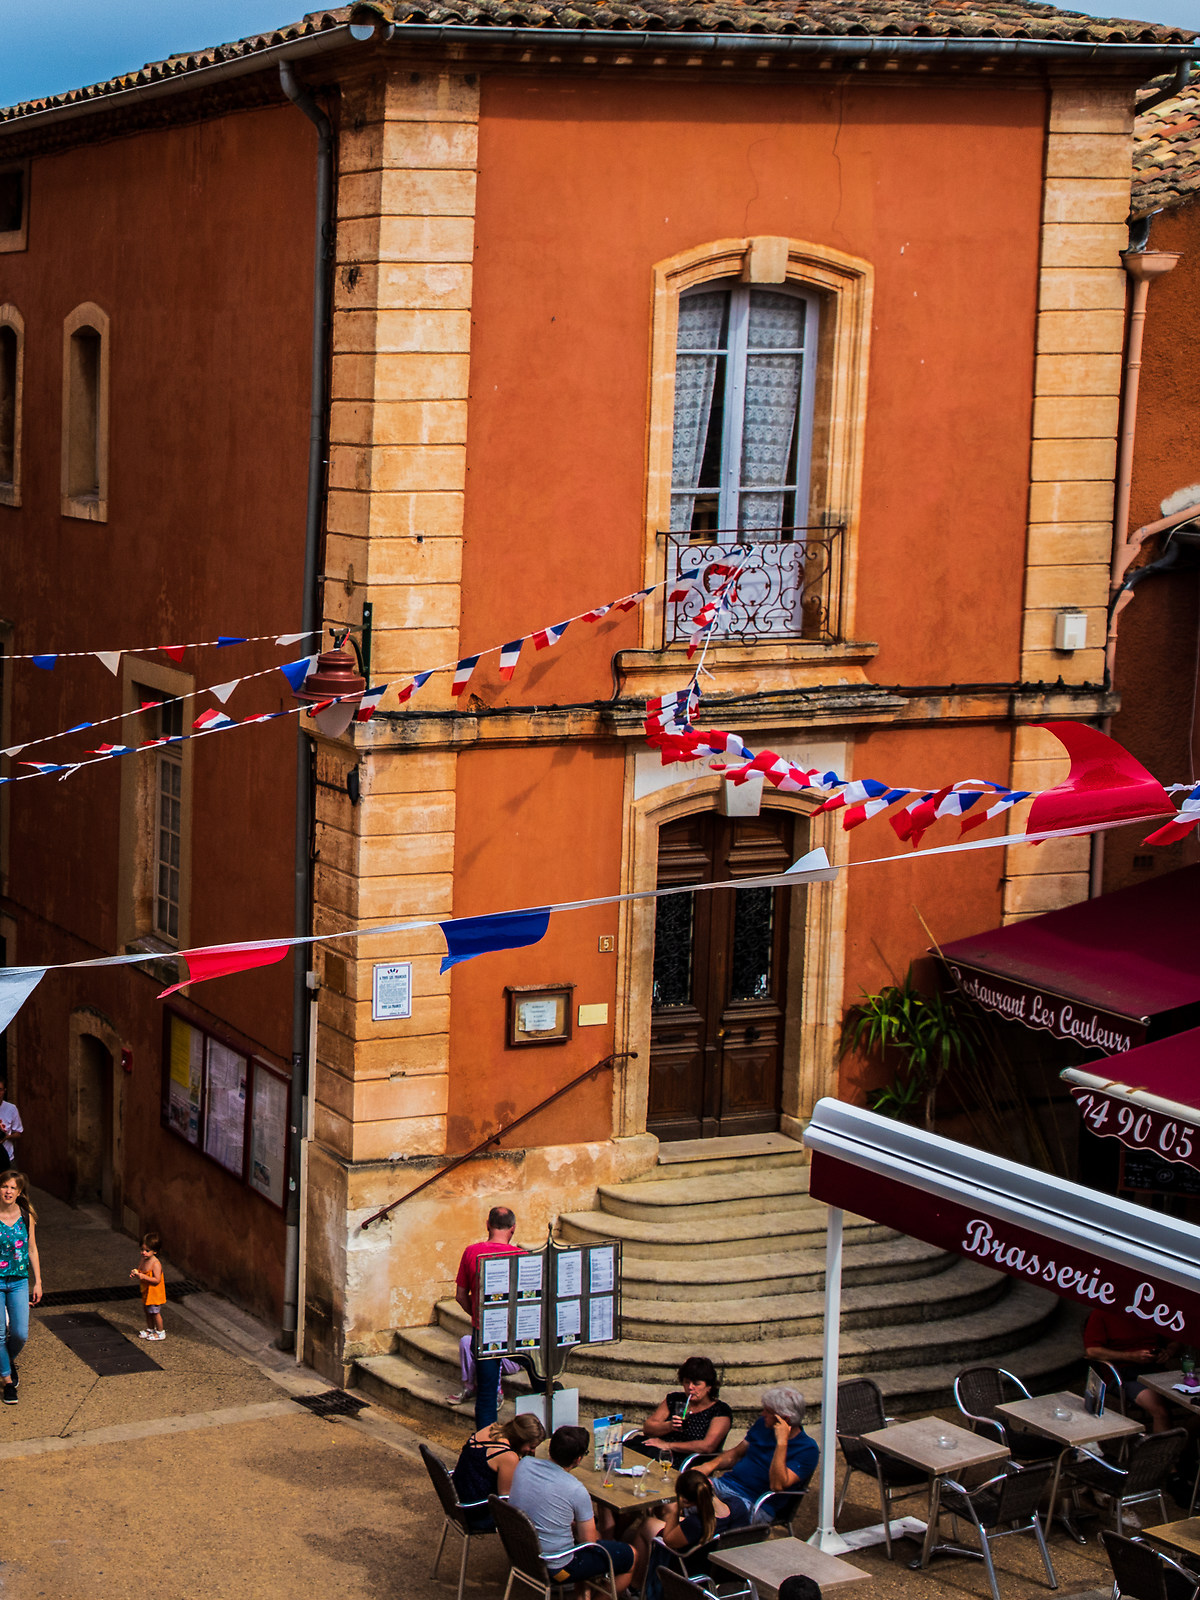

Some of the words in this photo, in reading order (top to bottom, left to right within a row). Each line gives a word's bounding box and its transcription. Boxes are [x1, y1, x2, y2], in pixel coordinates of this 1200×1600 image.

[603, 938, 610, 949] 5
[1029, 995, 1055, 1028] Les
[1059, 1005, 1131, 1052] Couleurs
[1117, 1107, 1152, 1142] 90
[1159, 1122, 1194, 1157] 05
[962, 1219, 1116, 1304] Brasserie
[1125, 1283, 1185, 1331] Les
